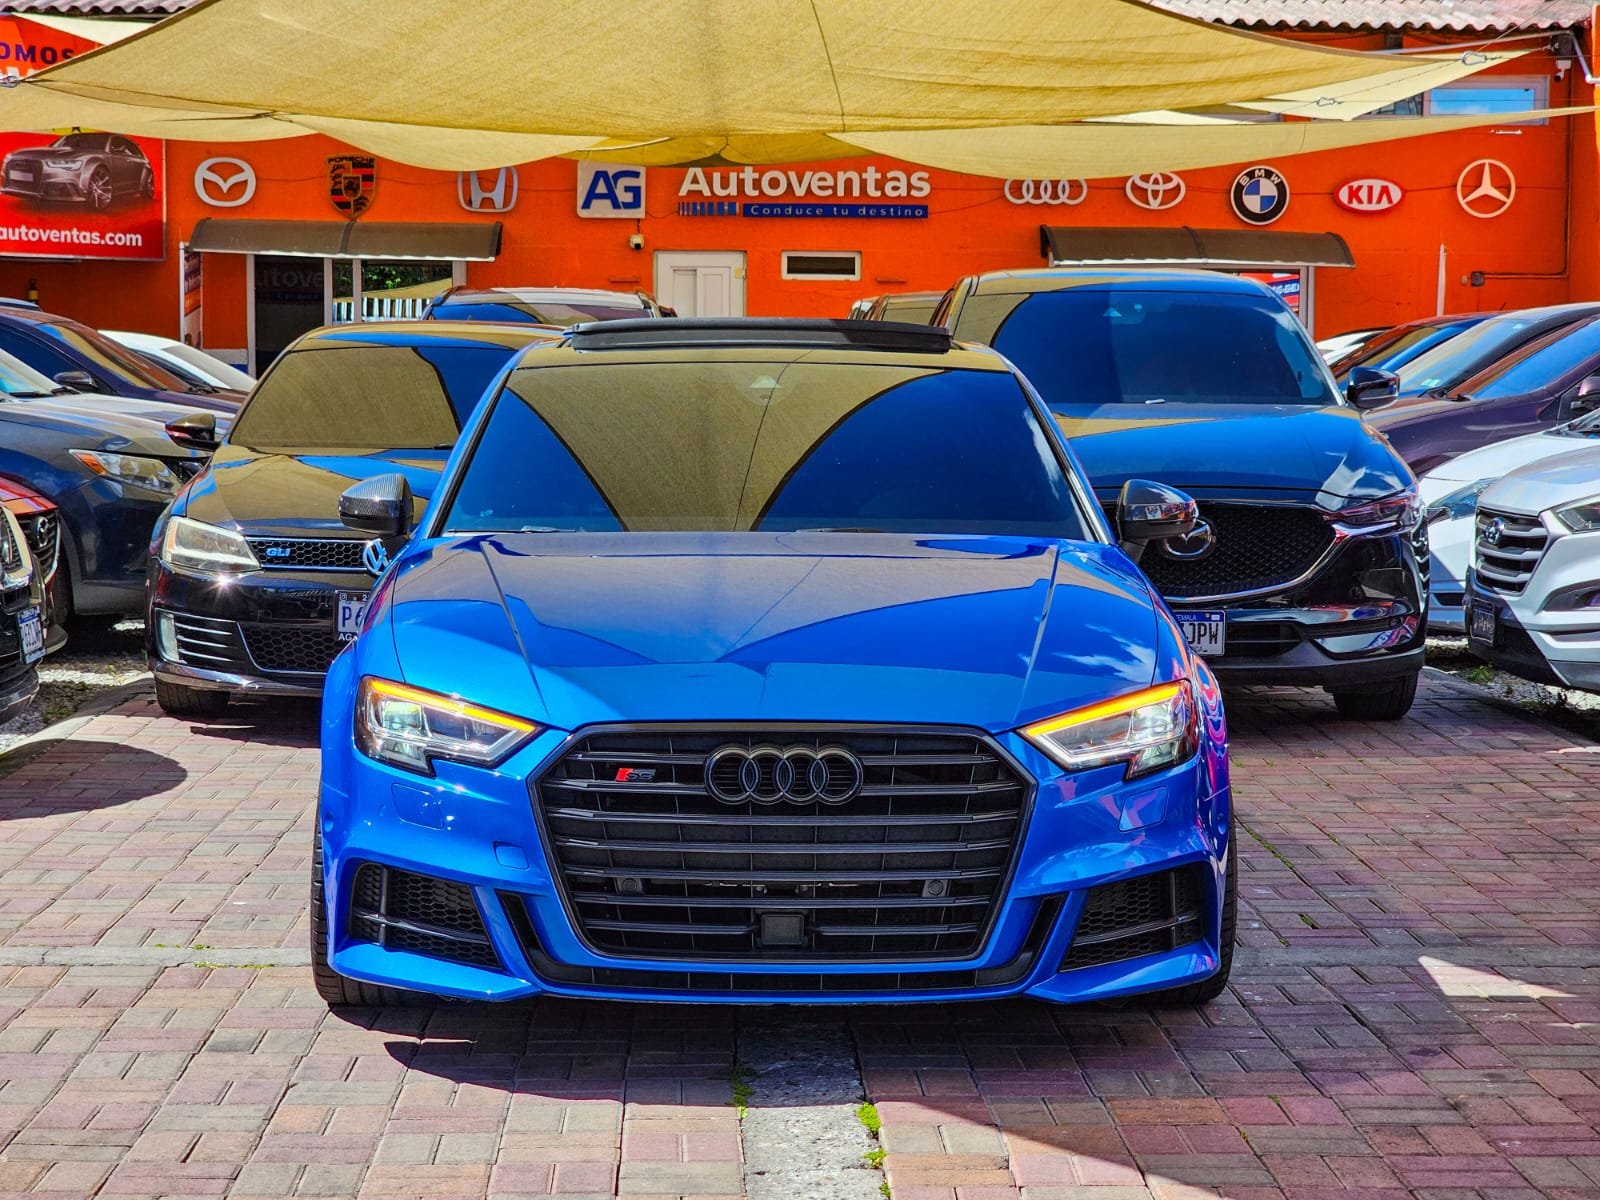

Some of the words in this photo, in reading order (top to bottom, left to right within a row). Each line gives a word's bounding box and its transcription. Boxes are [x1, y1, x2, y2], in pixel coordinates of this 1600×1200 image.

[678, 166, 931, 198] Autoventas
[1239, 169, 1281, 186] BMW
[581, 170, 642, 210] AG
[1347, 185, 1393, 205] KIA
[750, 205, 824, 216] Conduce
[832, 206, 849, 216] tu
[857, 206, 924, 217] destino
[0, 224, 142, 247] autoventas.com
[266, 547, 291, 558] GLI
[1181, 622, 1219, 645] JPW
